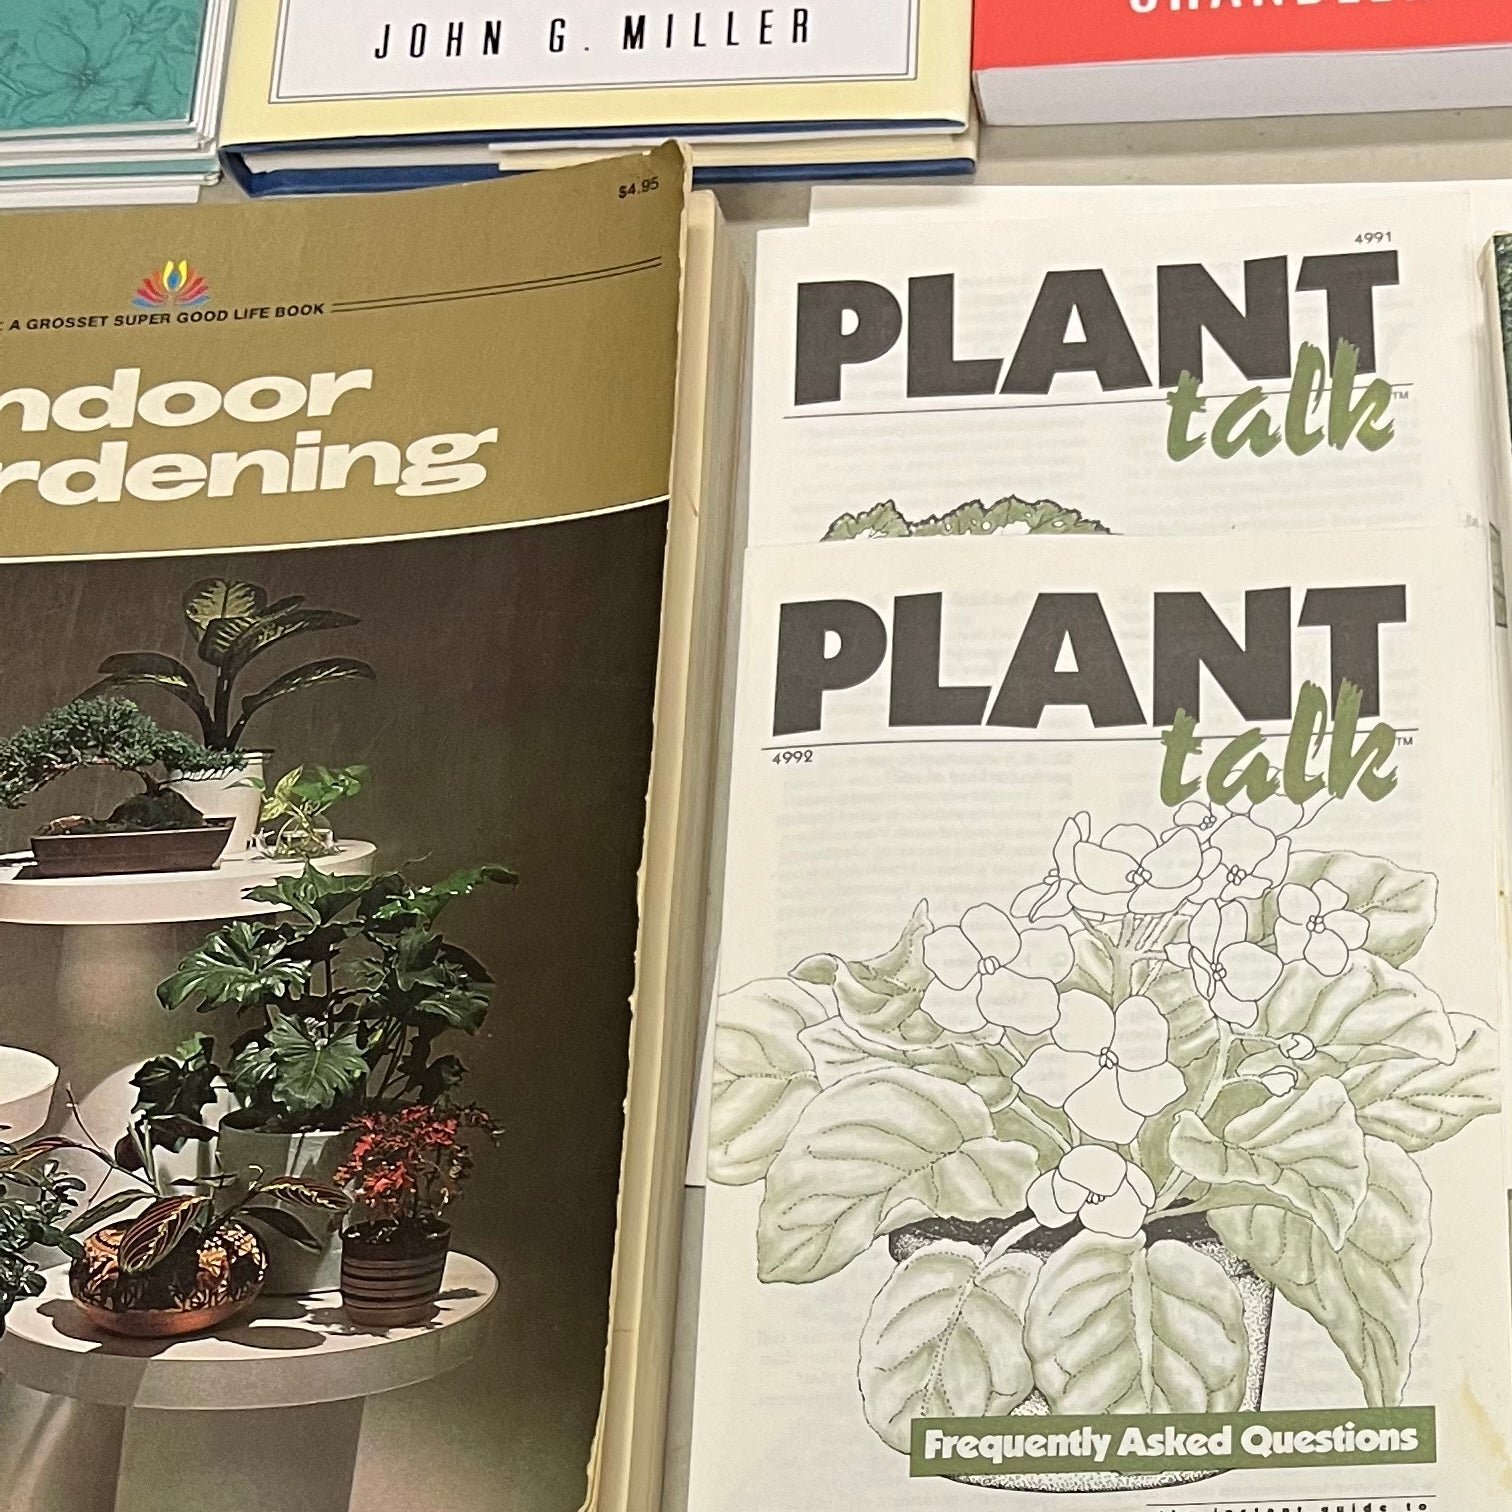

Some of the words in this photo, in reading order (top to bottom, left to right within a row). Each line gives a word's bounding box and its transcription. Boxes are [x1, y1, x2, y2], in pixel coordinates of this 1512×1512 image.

[374, 20, 502, 60] JOHN
[548, 18, 590, 53] G.
[622, 8, 810, 50] MILLER
[618, 175, 660, 199] $4.95
[1354, 231, 1393, 245] 4991
[9, 319, 21, 331] A
[26, 315, 109, 330] GROSSET
[113, 313, 171, 327] SUPER
[176, 309, 228, 324] GOOD
[233, 307, 269, 320] LIFE
[275, 303, 325, 318] BOOK
[794, 250, 1400, 406] PLANT
[1166, 338, 1395, 461] talk
[773, 584, 1407, 736] PLANT
[771, 750, 814, 765] 4992
[1160, 677, 1398, 807] talk
[924, 1426, 1112, 1464] Frequently
[1116, 1424, 1232, 1458] Asked
[1241, 1421, 1419, 1457] Questions
[1405, 1501, 1429, 1512] to
